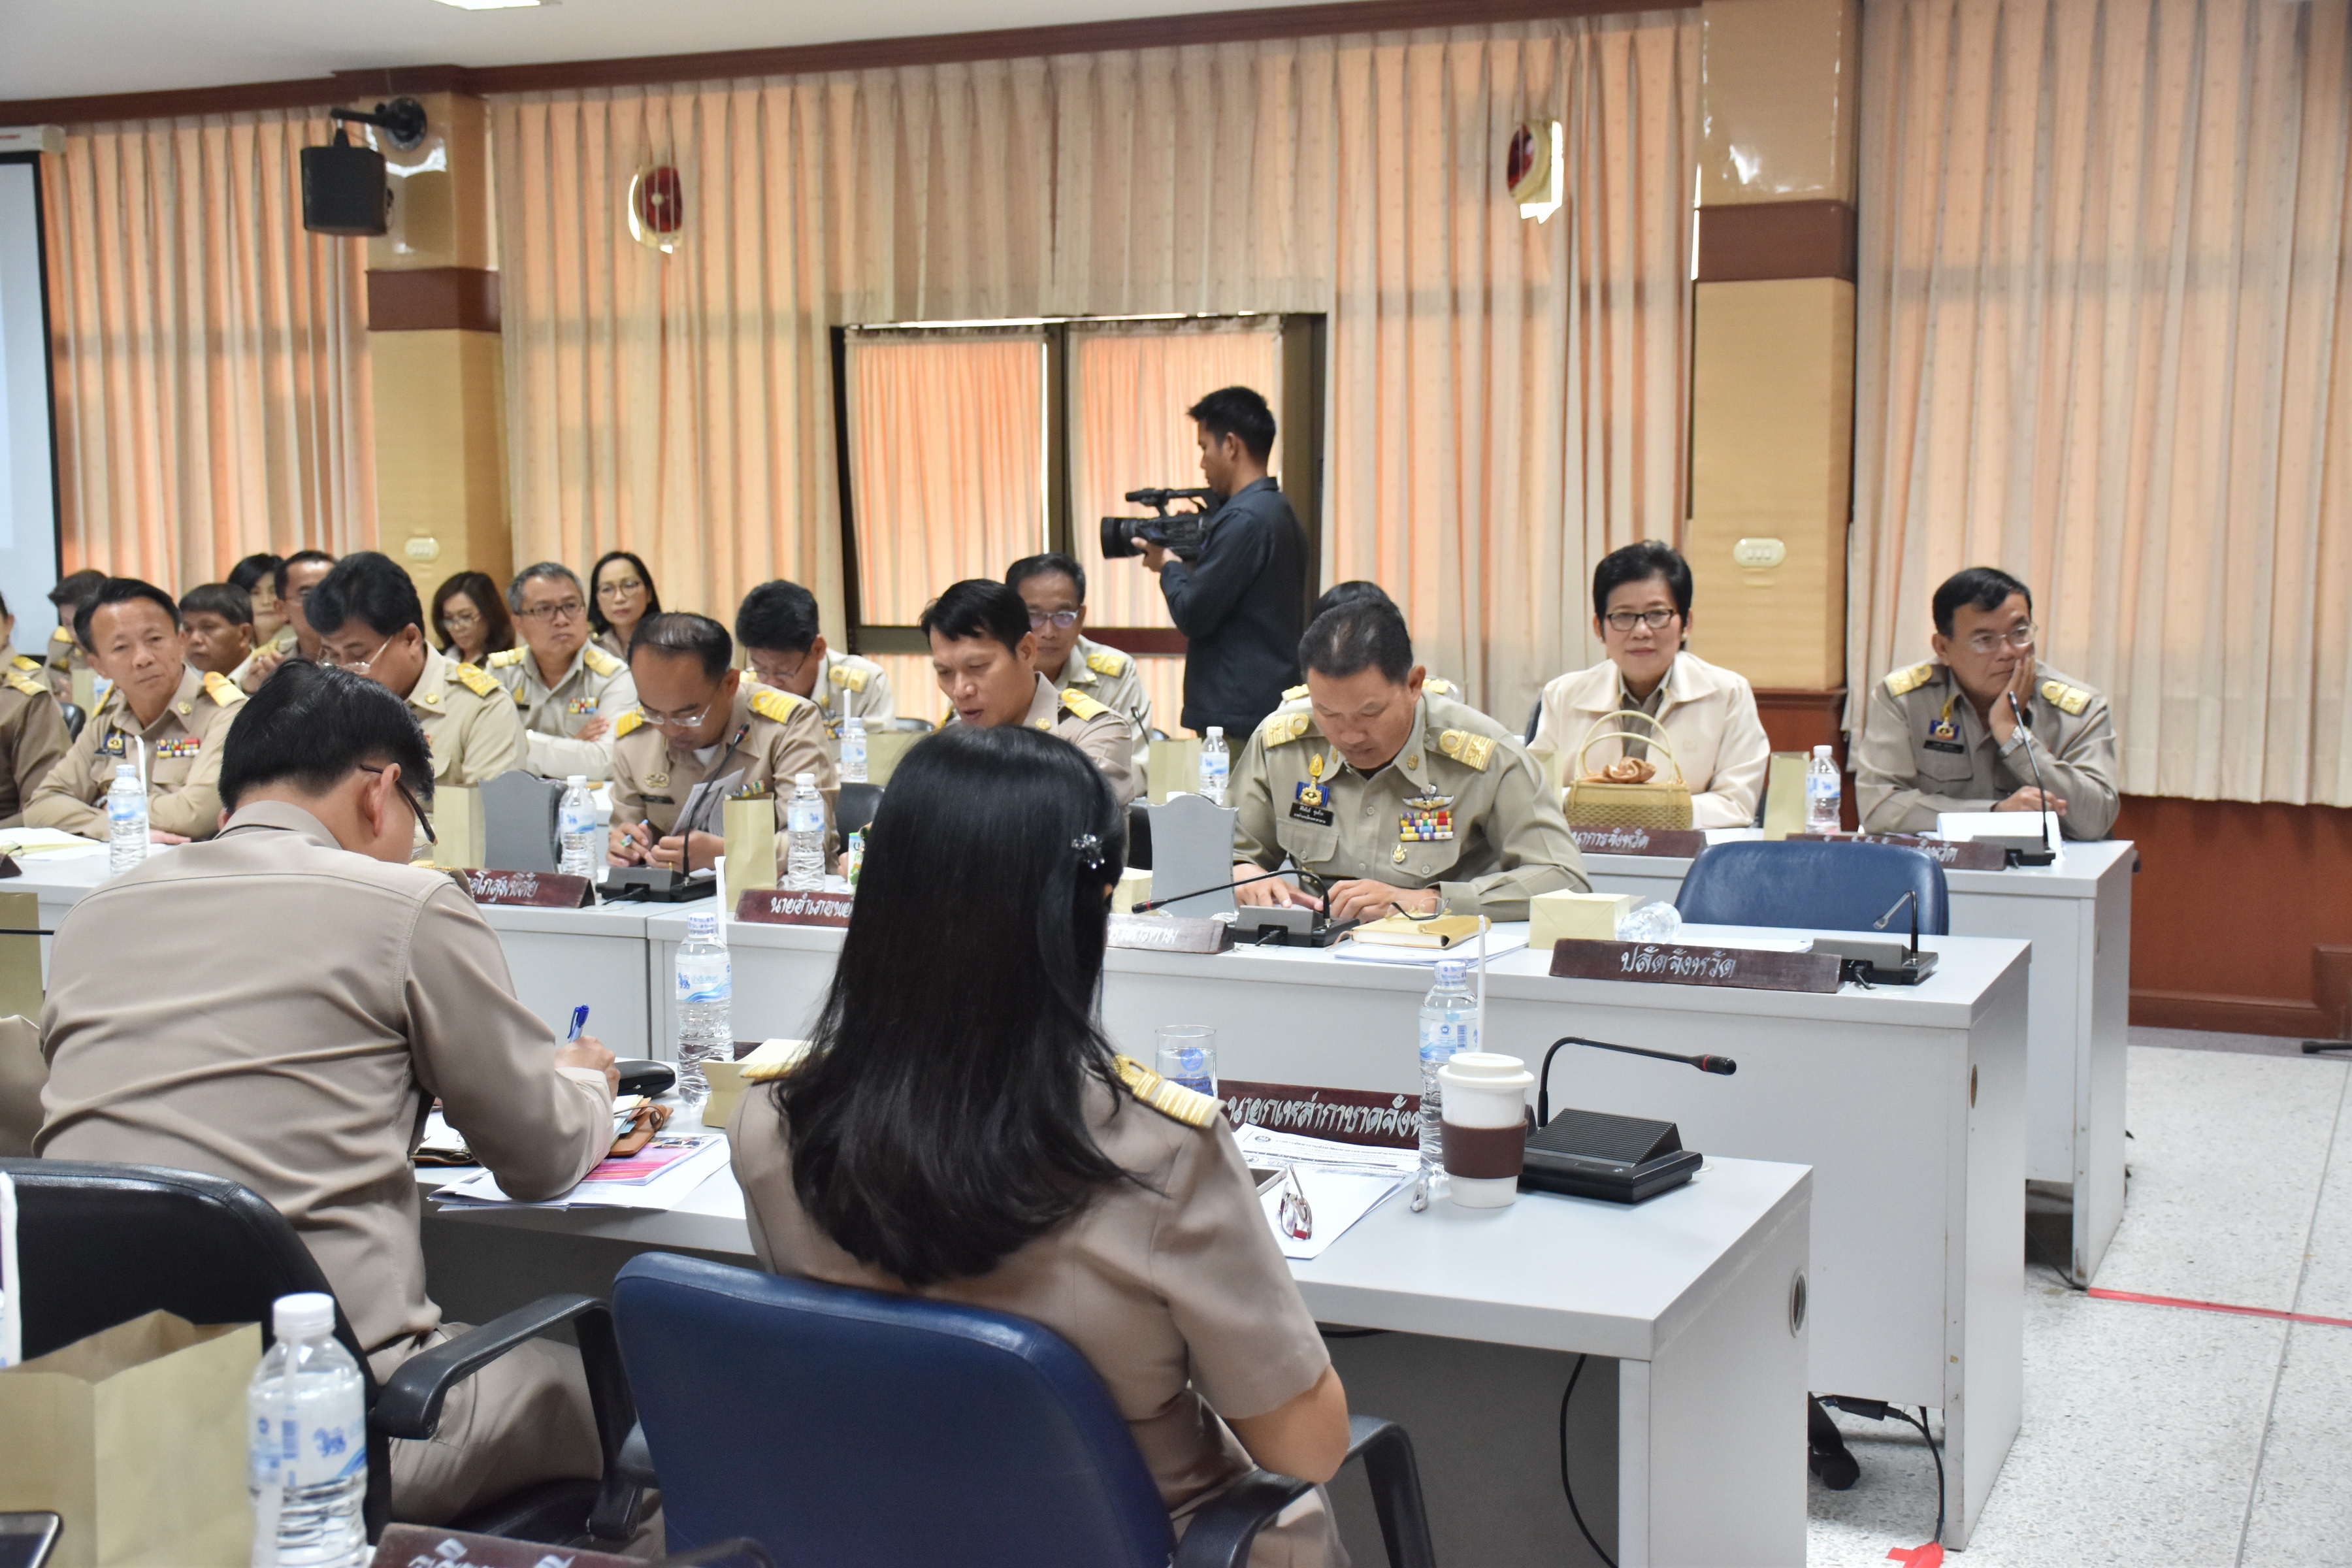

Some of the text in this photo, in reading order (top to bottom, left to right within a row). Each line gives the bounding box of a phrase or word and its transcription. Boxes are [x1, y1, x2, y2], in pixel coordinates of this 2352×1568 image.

[1571, 827, 1650, 849] นาการจังหวัด
[468, 870, 540, 902] อโกสุมพิสัย
[1620, 945, 1736, 978] ปลัดจังหวัด
[1227, 1092, 1420, 1137] นายกเหล่ากาชาดจังห
